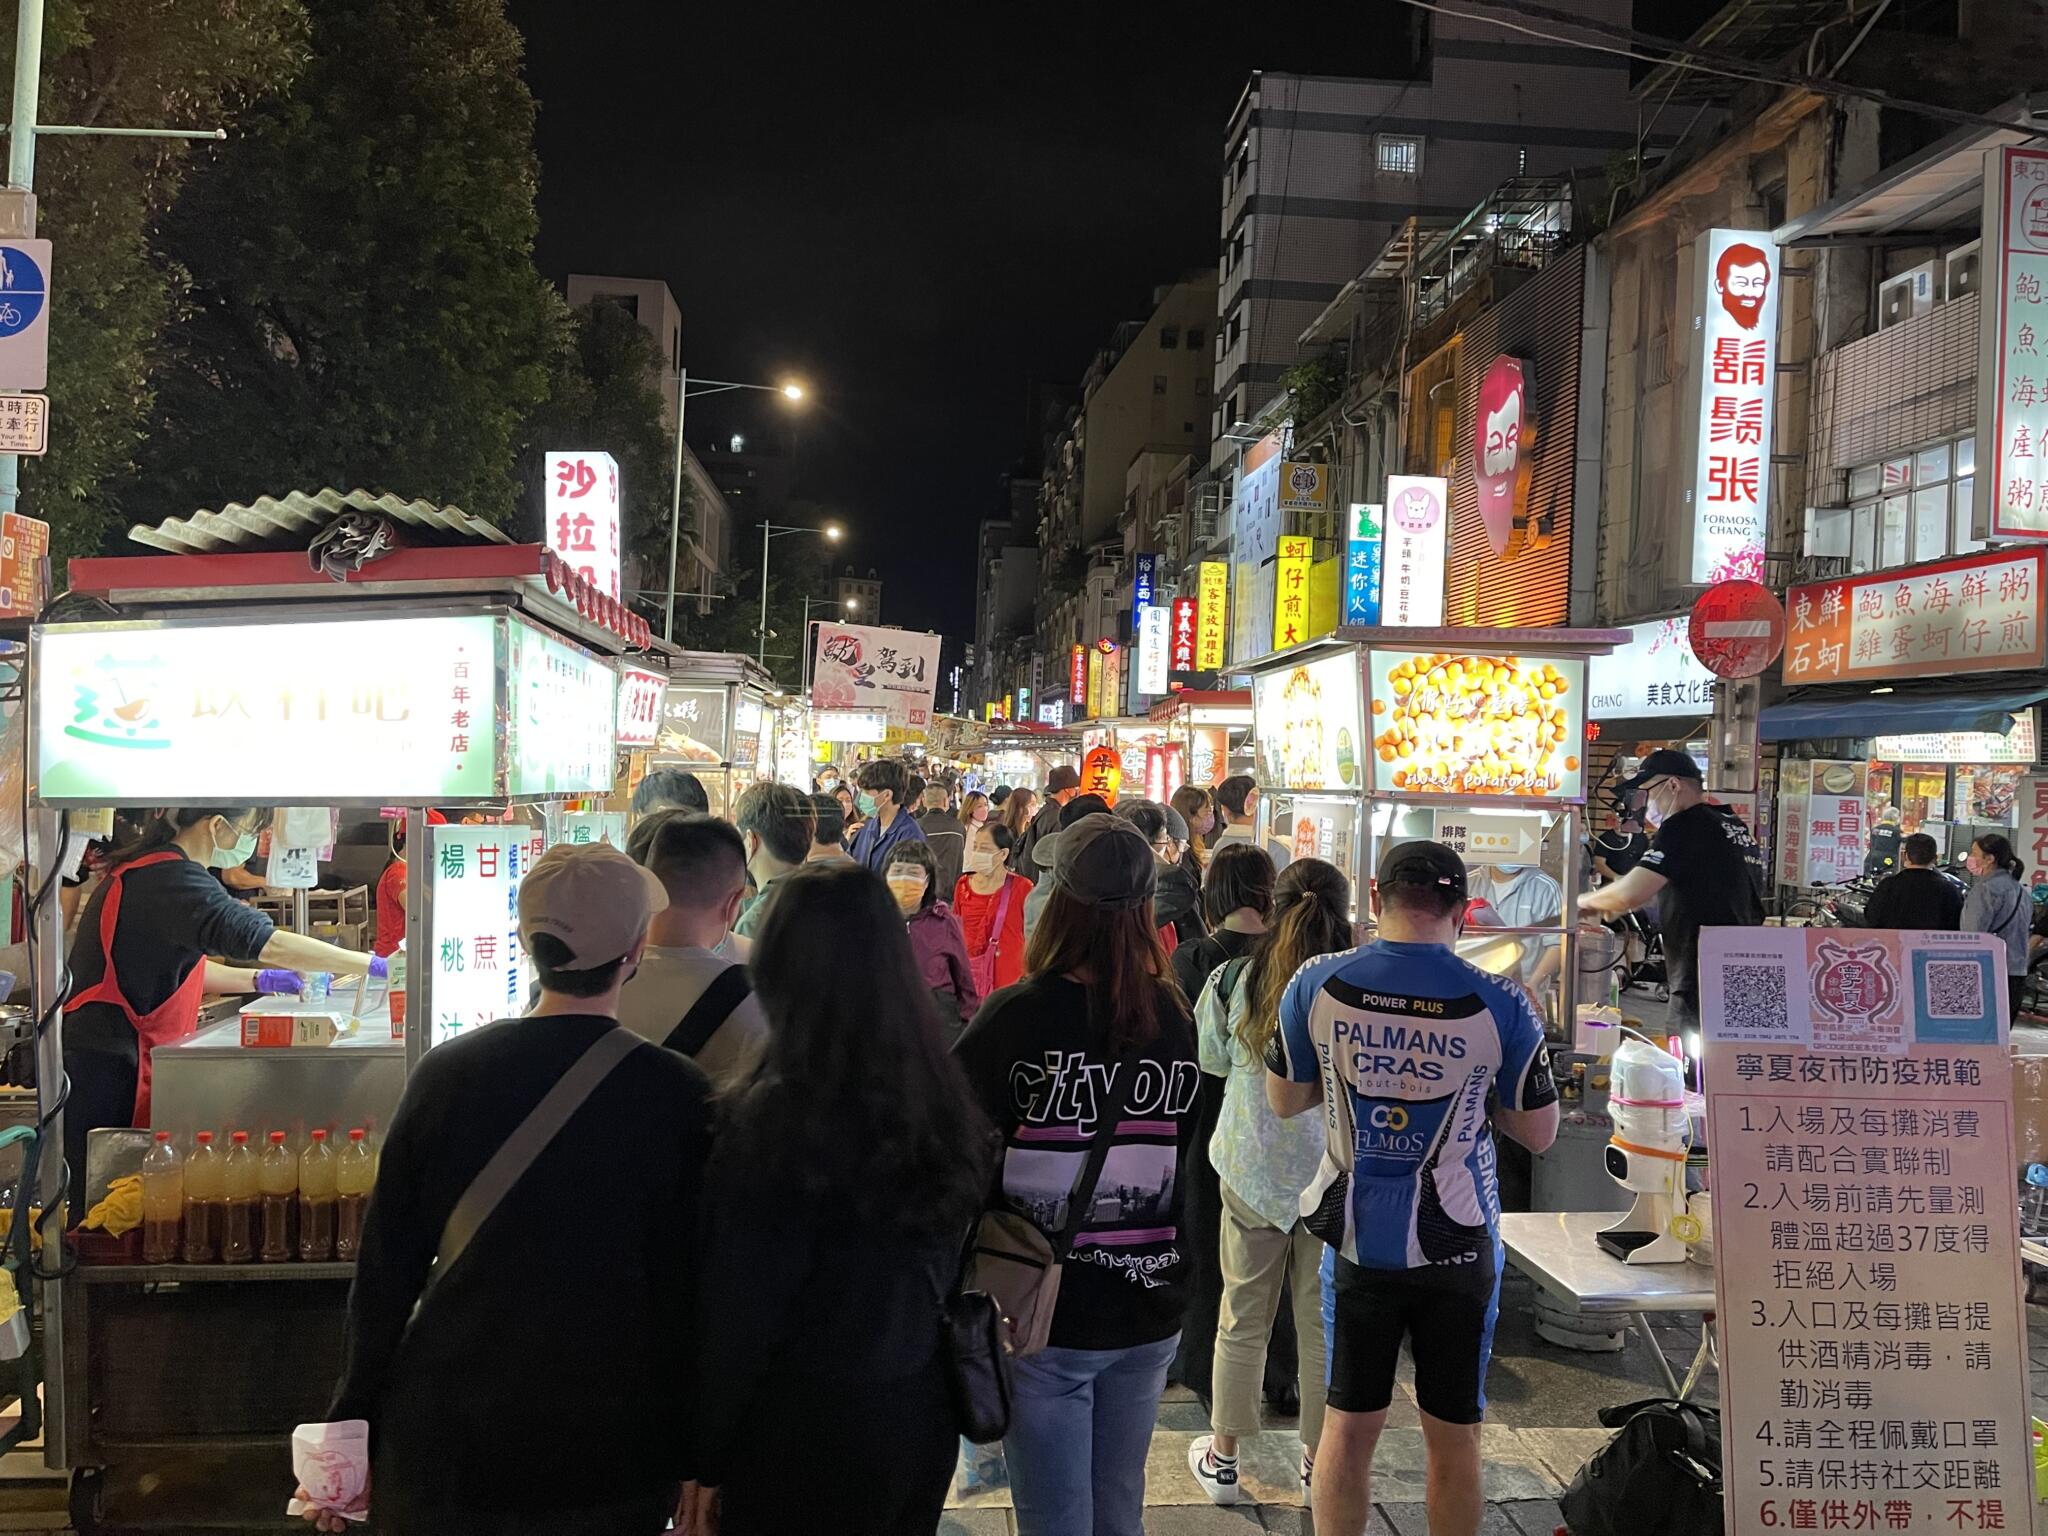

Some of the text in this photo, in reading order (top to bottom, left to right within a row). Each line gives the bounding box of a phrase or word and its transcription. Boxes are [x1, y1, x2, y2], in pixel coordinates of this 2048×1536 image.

[2007, 271, 2042, 510] 鮑魚海產粥
[1707, 337, 1766, 504] 鬍鬚張
[1703, 514, 1758, 526] FORMOSA
[1709, 525, 1751, 536] CHANG
[1274, 541, 1307, 644] 蚵仔煎大
[1856, 566, 2031, 622] 鮑魚海鮮粥
[450, 661, 471, 753] 百年老店
[1591, 693, 1622, 708] CHANG
[1647, 678, 1716, 706] 美食文化館
[1088, 754, 1114, 799] 牛五
[1405, 771, 1555, 788] sweet potato ball
[440, 844, 465, 1040] 楊桃汁
[1363, 994, 1444, 1014] POWER PLUS
[1837, 964, 1868, 1012] 寧夏
[1334, 1020, 1467, 1059] PALMANS
[1352, 1052, 1444, 1081] CRAS
[1736, 1053, 1981, 1087] 寧夏夜市防疫規範
[1319, 1042, 1339, 1132] PALMANS
[1457, 1064, 1489, 1143] PALMANS
[1740, 1106, 1980, 1138] 1.入場及每攤消費
[1764, 1144, 1951, 1176] 請配合實聯制
[1743, 1182, 1985, 1215] 2.入場前請先量測
[1770, 1221, 1990, 1253] 體溫超過37度得
[1773, 1259, 1897, 1292] 拒絕入場
[1751, 1300, 1992, 1331] 3.入口及每攤皆提
[1780, 1378, 1873, 1410] 勤消毒
[1755, 1419, 2000, 1450] 4.請全程佩戴口罩
[1759, 1459, 2002, 1490] 5.請保持社交距離
